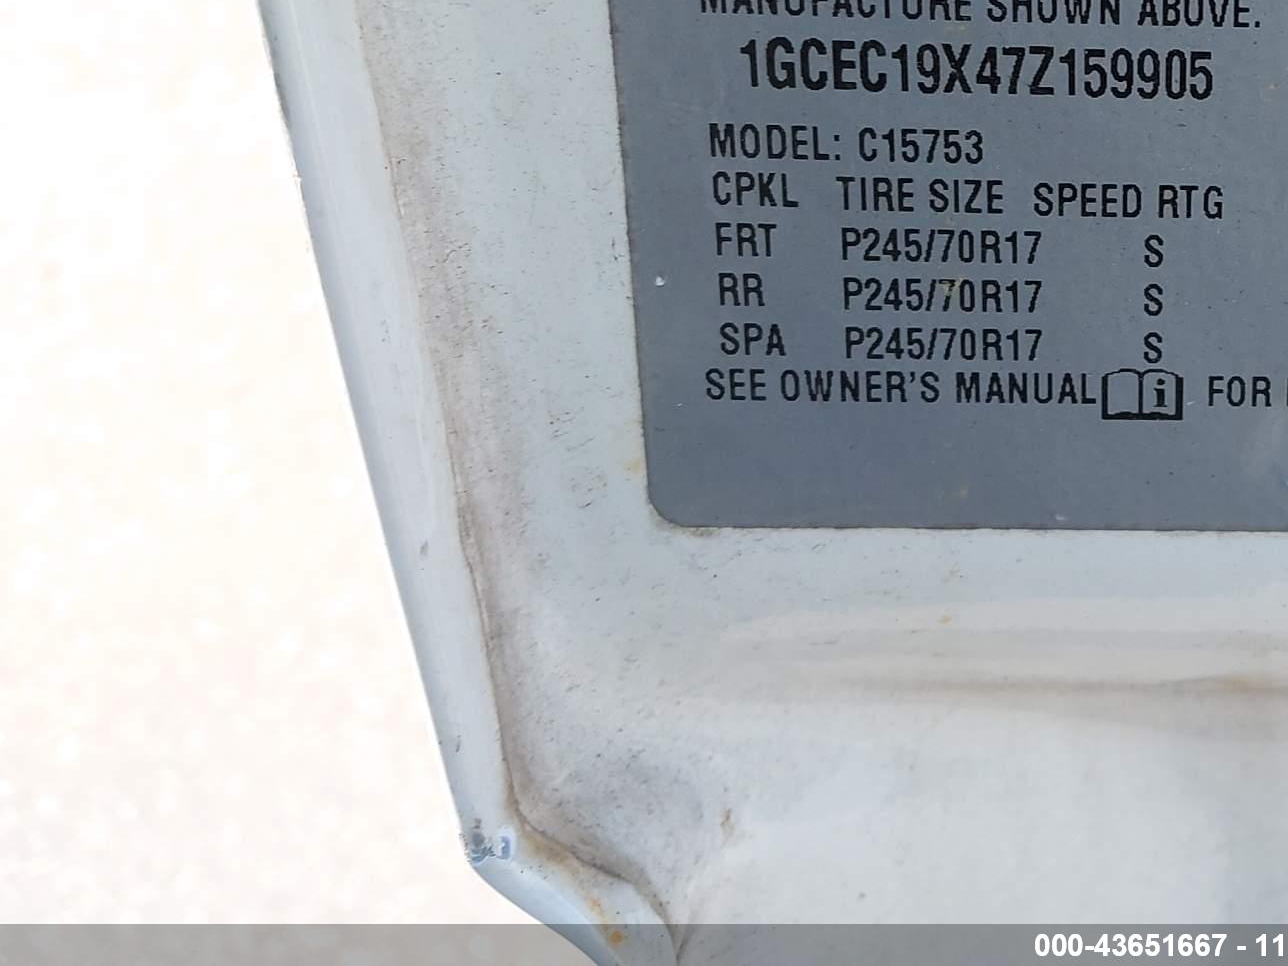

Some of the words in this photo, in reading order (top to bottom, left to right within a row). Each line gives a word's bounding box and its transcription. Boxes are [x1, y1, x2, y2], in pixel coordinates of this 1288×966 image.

[740, 37, 1213, 100] 1GCEC19X47Z159905
[709, 123, 840, 160] MODEL:
[859, 128, 983, 164] C15753
[713, 171, 798, 207] CPKL
[836, 177, 914, 212] TIRE
[929, 179, 1003, 214] SIZE
[1034, 183, 1141, 217] SPEED
[1158, 185, 1223, 219] RTG
[715, 223, 777, 257] FRT
[842, 228, 1041, 264] P245/70R17
[1144, 235, 1163, 267] S
[719, 273, 765, 306] RR
[843, 277, 1042, 313] P245/70R17
[1144, 284, 1163, 316] S
[720, 323, 786, 356] SPA
[846, 327, 1042, 361] P245/70R17
[1144, 332, 1162, 363] S
[706, 368, 766, 401] SEE
[781, 370, 939, 402] OWNER'S
[956, 372, 1096, 404] MANUAL
[1208, 376, 1271, 407] FOR
